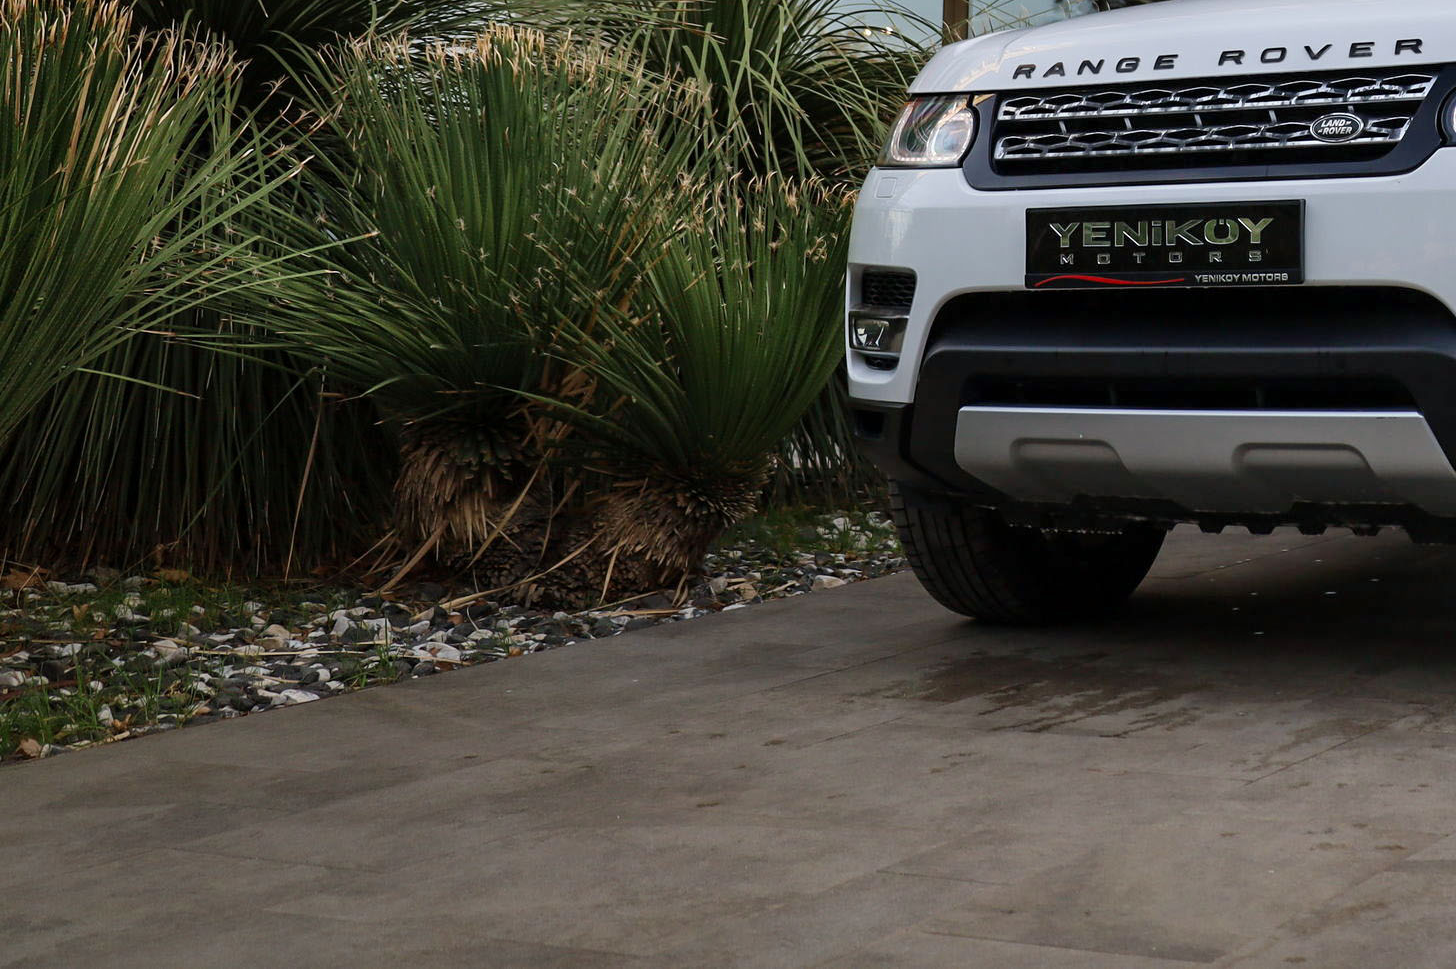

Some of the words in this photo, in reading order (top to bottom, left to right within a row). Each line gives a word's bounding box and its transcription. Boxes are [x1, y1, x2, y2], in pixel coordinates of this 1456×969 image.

[1012, 53, 1179, 80] RANGE
[1217, 38, 1424, 67] ROVER
[1321, 119, 1346, 128] LAND
[1322, 126, 1353, 135] ROVER
[1060, 250, 1263, 265] MOTORS
[1242, 272, 1289, 282] MOTORS
